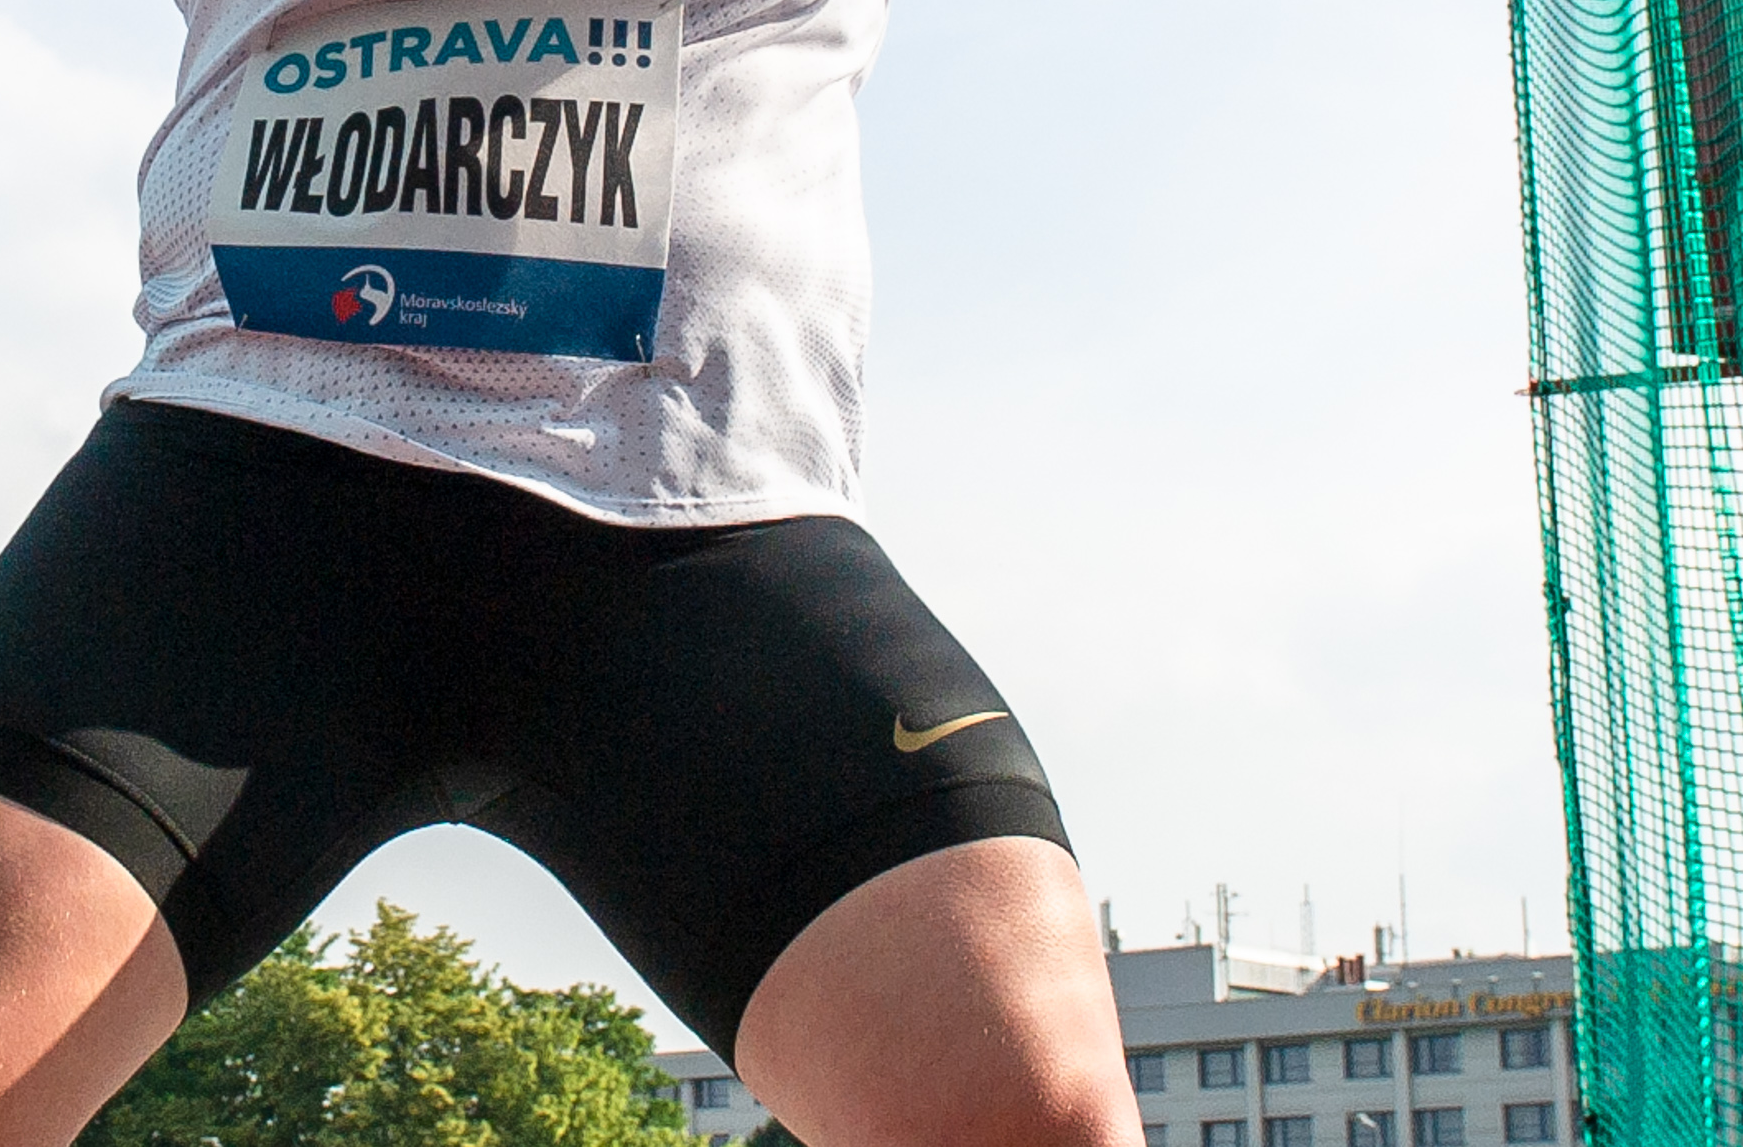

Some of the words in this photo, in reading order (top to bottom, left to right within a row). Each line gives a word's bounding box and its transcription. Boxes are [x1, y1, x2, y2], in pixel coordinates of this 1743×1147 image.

[263, 17, 653, 94] OSTRAVA!!!
[239, 94, 645, 229] WŁODARCZYK
[399, 292, 529, 320] Moravskoslezský
[399, 310, 428, 328] kraj
